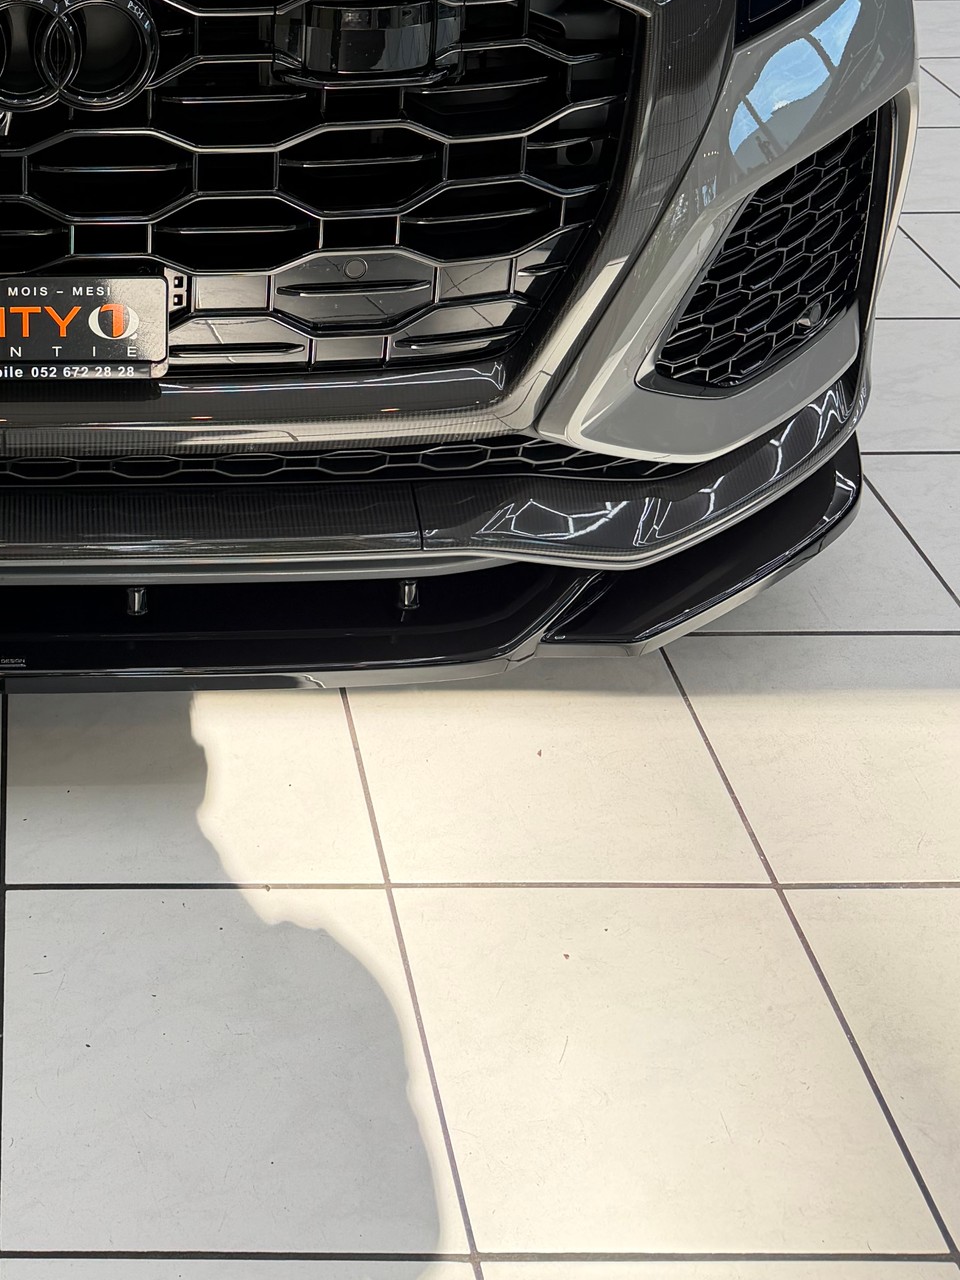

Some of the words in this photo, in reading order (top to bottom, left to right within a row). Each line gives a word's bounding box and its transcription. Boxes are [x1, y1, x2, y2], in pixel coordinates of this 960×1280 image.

[8, 286, 48, 296] MOIS
[72, 286, 111, 296] MESI
[31, 366, 58, 378] 052
[63, 366, 89, 378] 672
[95, 366, 112, 378] 28
[118, 366, 135, 378] 28
